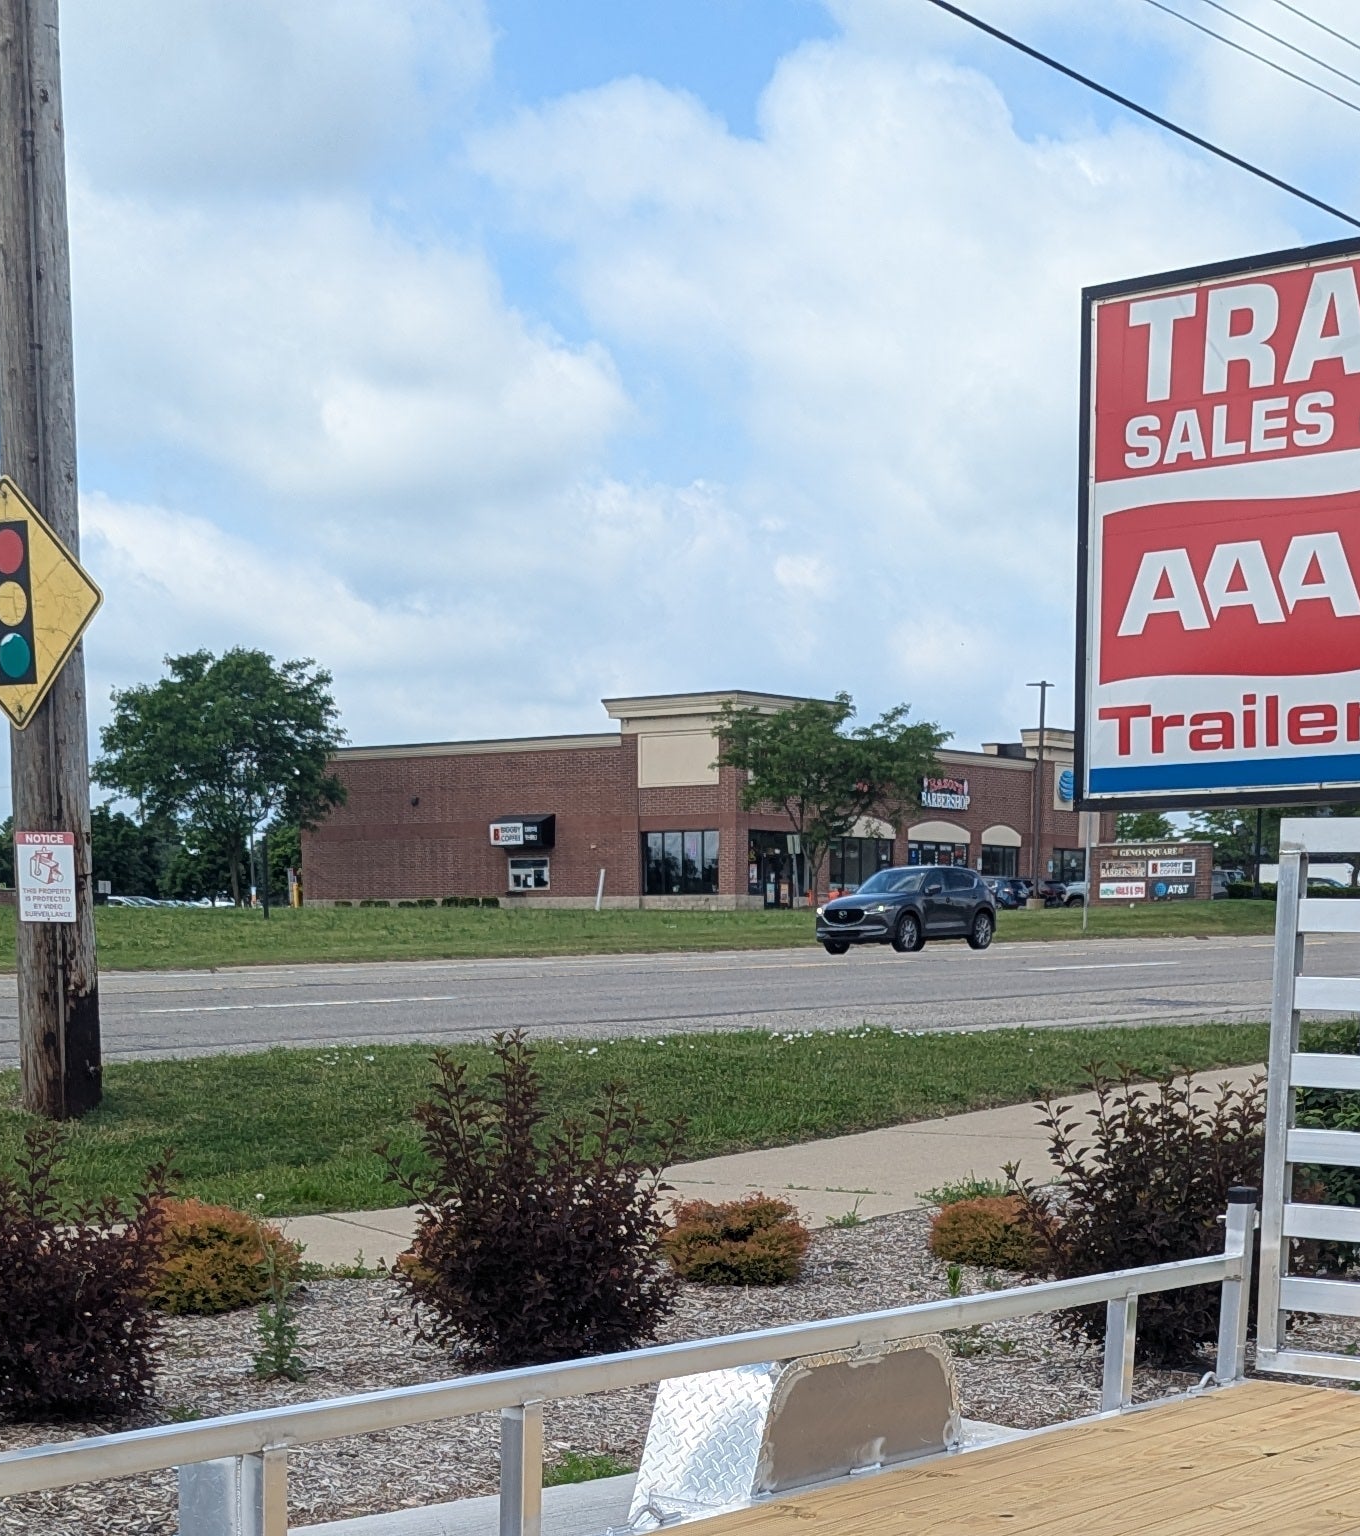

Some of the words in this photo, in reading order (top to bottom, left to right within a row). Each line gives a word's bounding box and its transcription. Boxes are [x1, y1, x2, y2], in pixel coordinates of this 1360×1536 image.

[1124, 390, 1335, 469] SALES
[921, 791, 970, 810] BARBERSHOP
[25, 833, 64, 844] NOTICE
[1119, 848, 1146, 857] GENOA
[1147, 847, 1178, 857] SQUARE
[1167, 884, 1190, 895] AT&T
